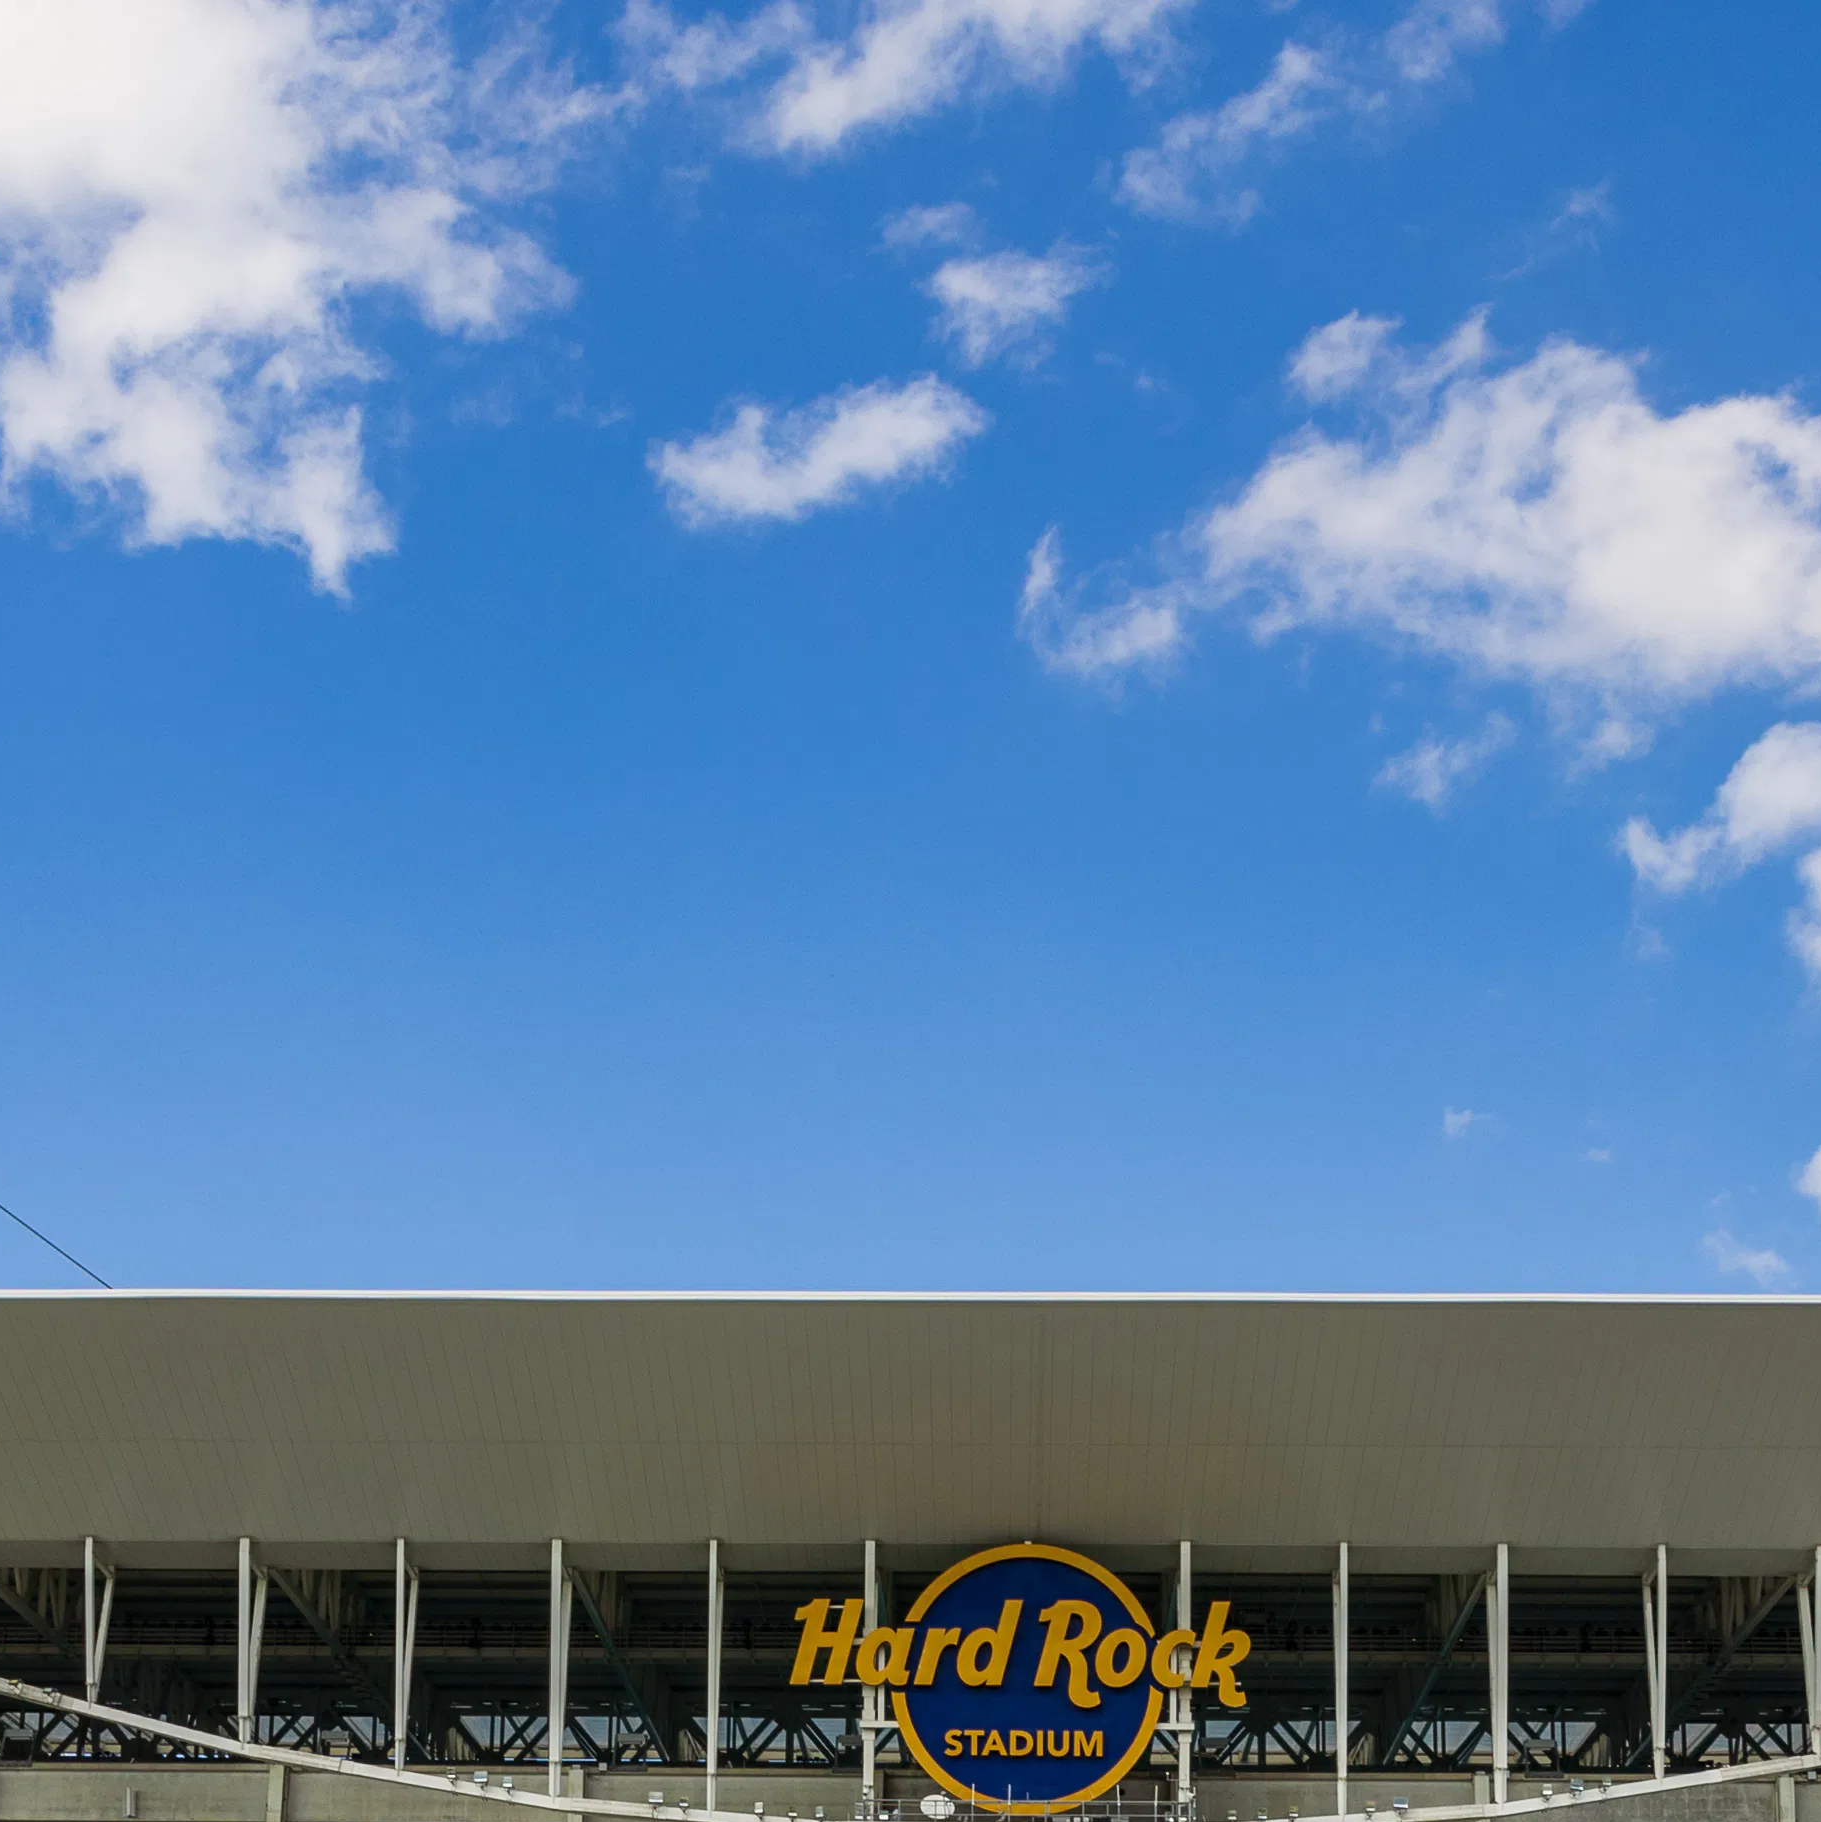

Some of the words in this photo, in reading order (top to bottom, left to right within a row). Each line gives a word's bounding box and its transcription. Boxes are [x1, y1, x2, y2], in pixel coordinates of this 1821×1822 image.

[789, 1598, 1024, 1688] Hard
[1033, 1599, 1252, 1709] Rock
[943, 1729, 1104, 1758] STADIUM
